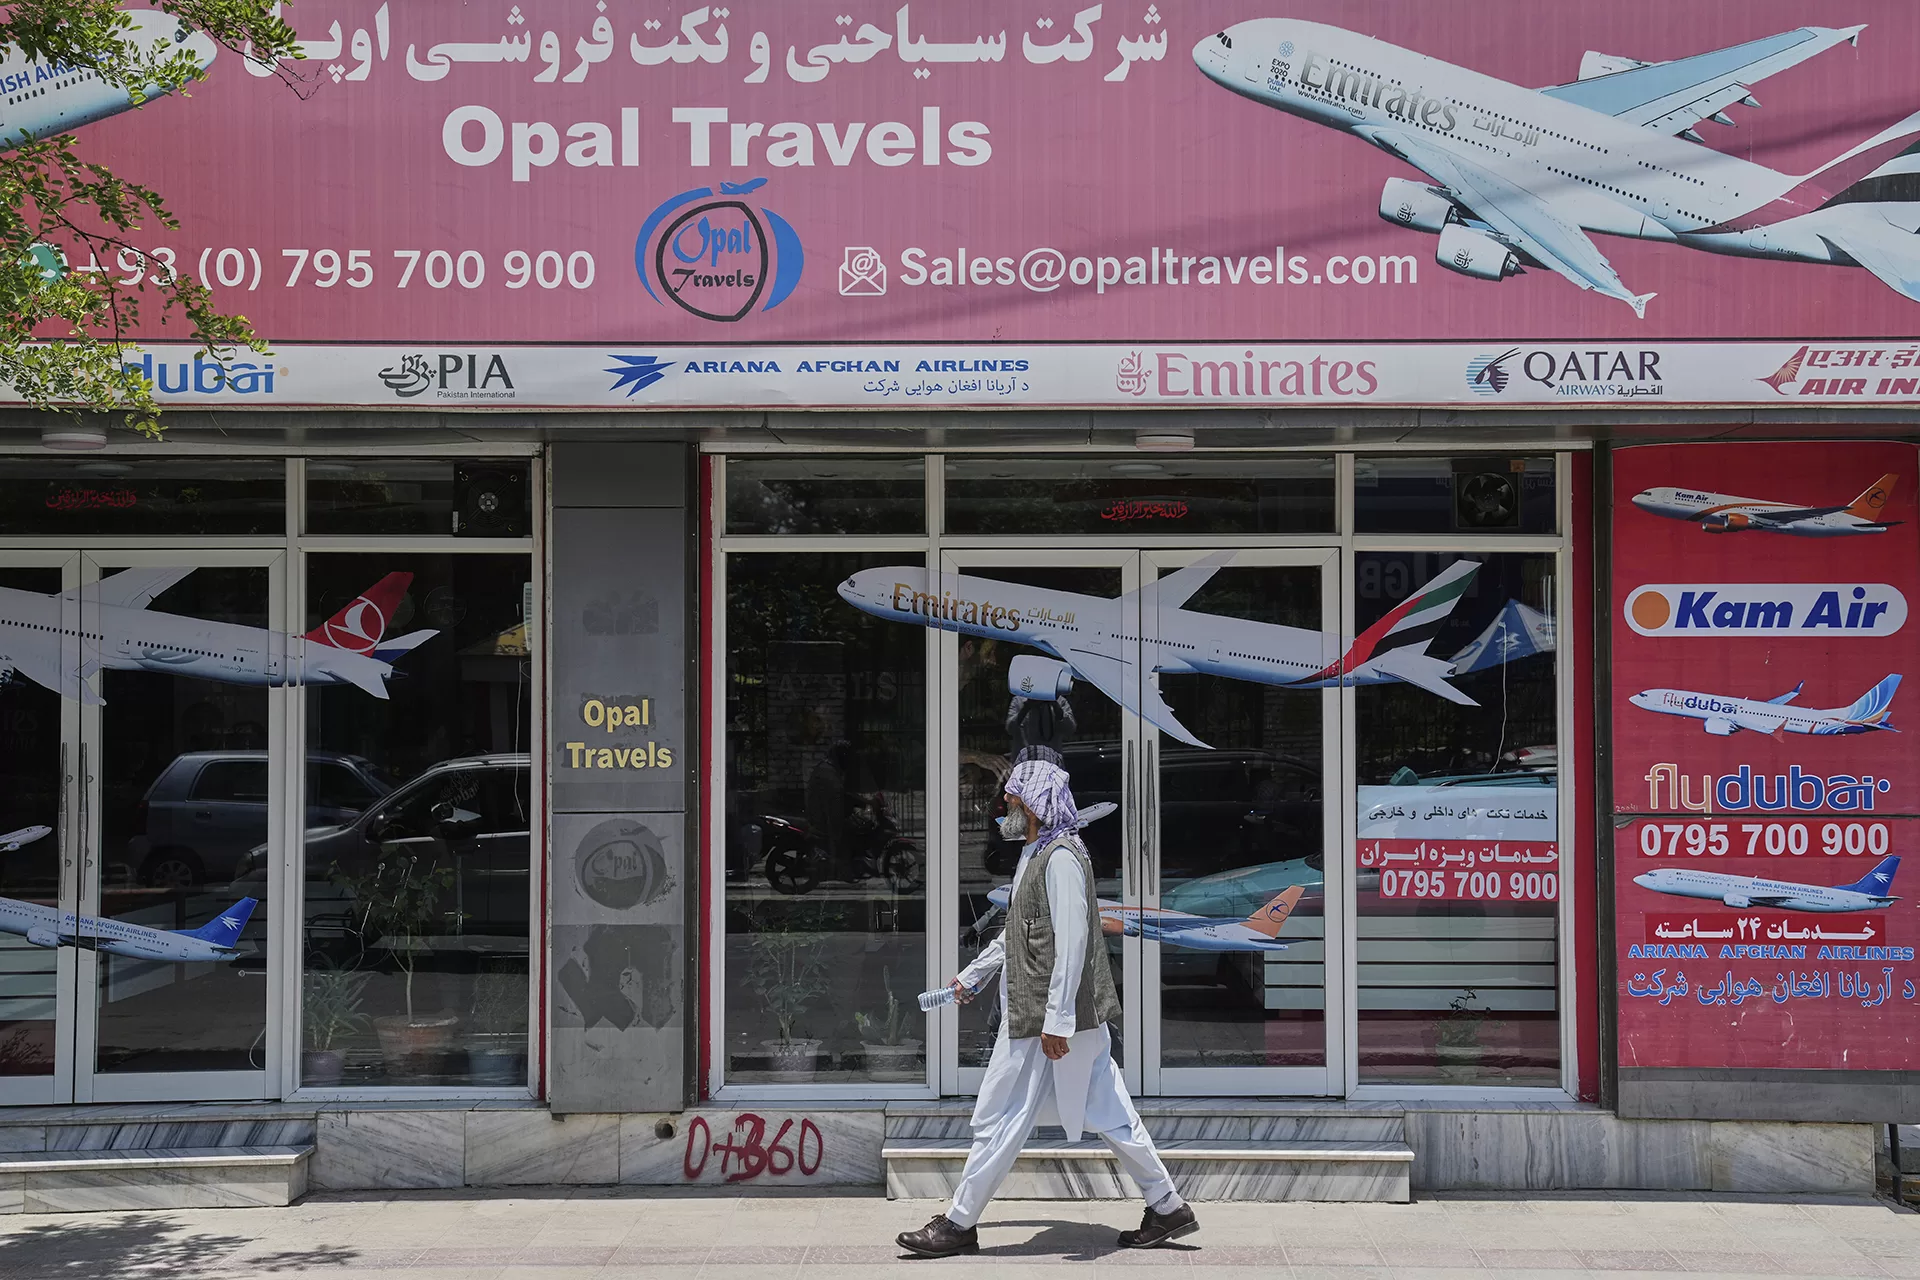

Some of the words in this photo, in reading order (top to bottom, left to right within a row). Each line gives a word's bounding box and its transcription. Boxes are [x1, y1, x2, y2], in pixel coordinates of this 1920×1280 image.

[406, 3, 614, 84] فروشی
[630, 7, 730, 66] تکت
[786, 4, 1006, 83] سیاحتی
[1022, 3, 1168, 82] شرکت
[743, 32, 771, 84] و
[1271, 58, 1291, 70] EXPO
[1270, 66, 1288, 78] 2020
[1300, 50, 1459, 131] Emirates
[442, 105, 639, 182] Opal
[672, 106, 992, 167] Travels
[672, 217, 751, 267] Opal
[76, 246, 178, 287] +93
[198, 247, 262, 291] (0)
[282, 250, 374, 288] 795
[394, 250, 486, 289] 700
[504, 250, 595, 289] 900
[672, 268, 755, 292] Travels
[899, 246, 1418, 294] Sales@opaltravels.com
[438, 354, 514, 389] PIA
[683, 359, 782, 374] ARIANA
[796, 360, 900, 373] AFGHAN
[915, 359, 1030, 373] AIRLINES
[1155, 350, 1379, 396] Emirates
[1523, 350, 1662, 388] QATAR
[437, 390, 469, 399] Pakistan
[470, 390, 515, 399] International
[863, 379, 900, 397] شرکت
[947, 379, 982, 394] افغان
[985, 378, 1017, 397] آریانا
[1556, 385, 1615, 396] AIRWAYS
[1617, 385, 1663, 396] القطرية
[1798, 378, 1868, 395] AIR
[1876, 378, 1920, 395] IN
[1674, 491, 1694, 500] Kam
[1696, 494, 1708, 502] Air
[892, 583, 1020, 631] Emirates
[1674, 591, 1793, 628] Kam
[1801, 586, 1888, 628] Air
[1663, 692, 1743, 715] flydubai
[583, 699, 650, 733] Opal
[566, 742, 673, 769] Travels
[1645, 763, 1876, 820] flydubai
[1369, 806, 1405, 821] خارجی
[1409, 810, 1416, 820] و
[1423, 806, 1453, 822] داخلی
[1487, 808, 1510, 820] تکت
[1513, 809, 1549, 820] خدمات
[1640, 824, 1729, 856] 0795
[1742, 824, 1809, 856] 700
[1821, 823, 1889, 856] 900
[1360, 841, 1425, 866] ایران
[1429, 846, 1475, 868] ویزه
[1479, 843, 1558, 865] خدمات
[1382, 870, 1445, 897] 0795
[1454, 872, 1501, 898] 700
[1510, 873, 1557, 899] 900
[1751, 881, 1773, 889] ARIANA
[1774, 883, 1797, 891] AFGHAN
[1798, 886, 1823, 894] AIRLINES
[65, 914, 94, 924] ARANA
[96, 921, 124, 930] AFGHAN
[125, 927, 157, 937] AIRLINES
[1655, 918, 1734, 939] ساعته
[1738, 917, 1761, 940] ۲۴
[1767, 919, 1876, 941] خدمات
[1628, 944, 1707, 958] ARIANA
[1719, 945, 1805, 959] AFGHAN
[1817, 946, 1914, 960] AIRLINES
[1627, 969, 1688, 1004] شرکت
[1697, 971, 1763, 1004] هوایی
[1772, 971, 1829, 1004] افغان
[1838, 968, 1893, 1007] آریانا
[1903, 979, 1915, 999] د
